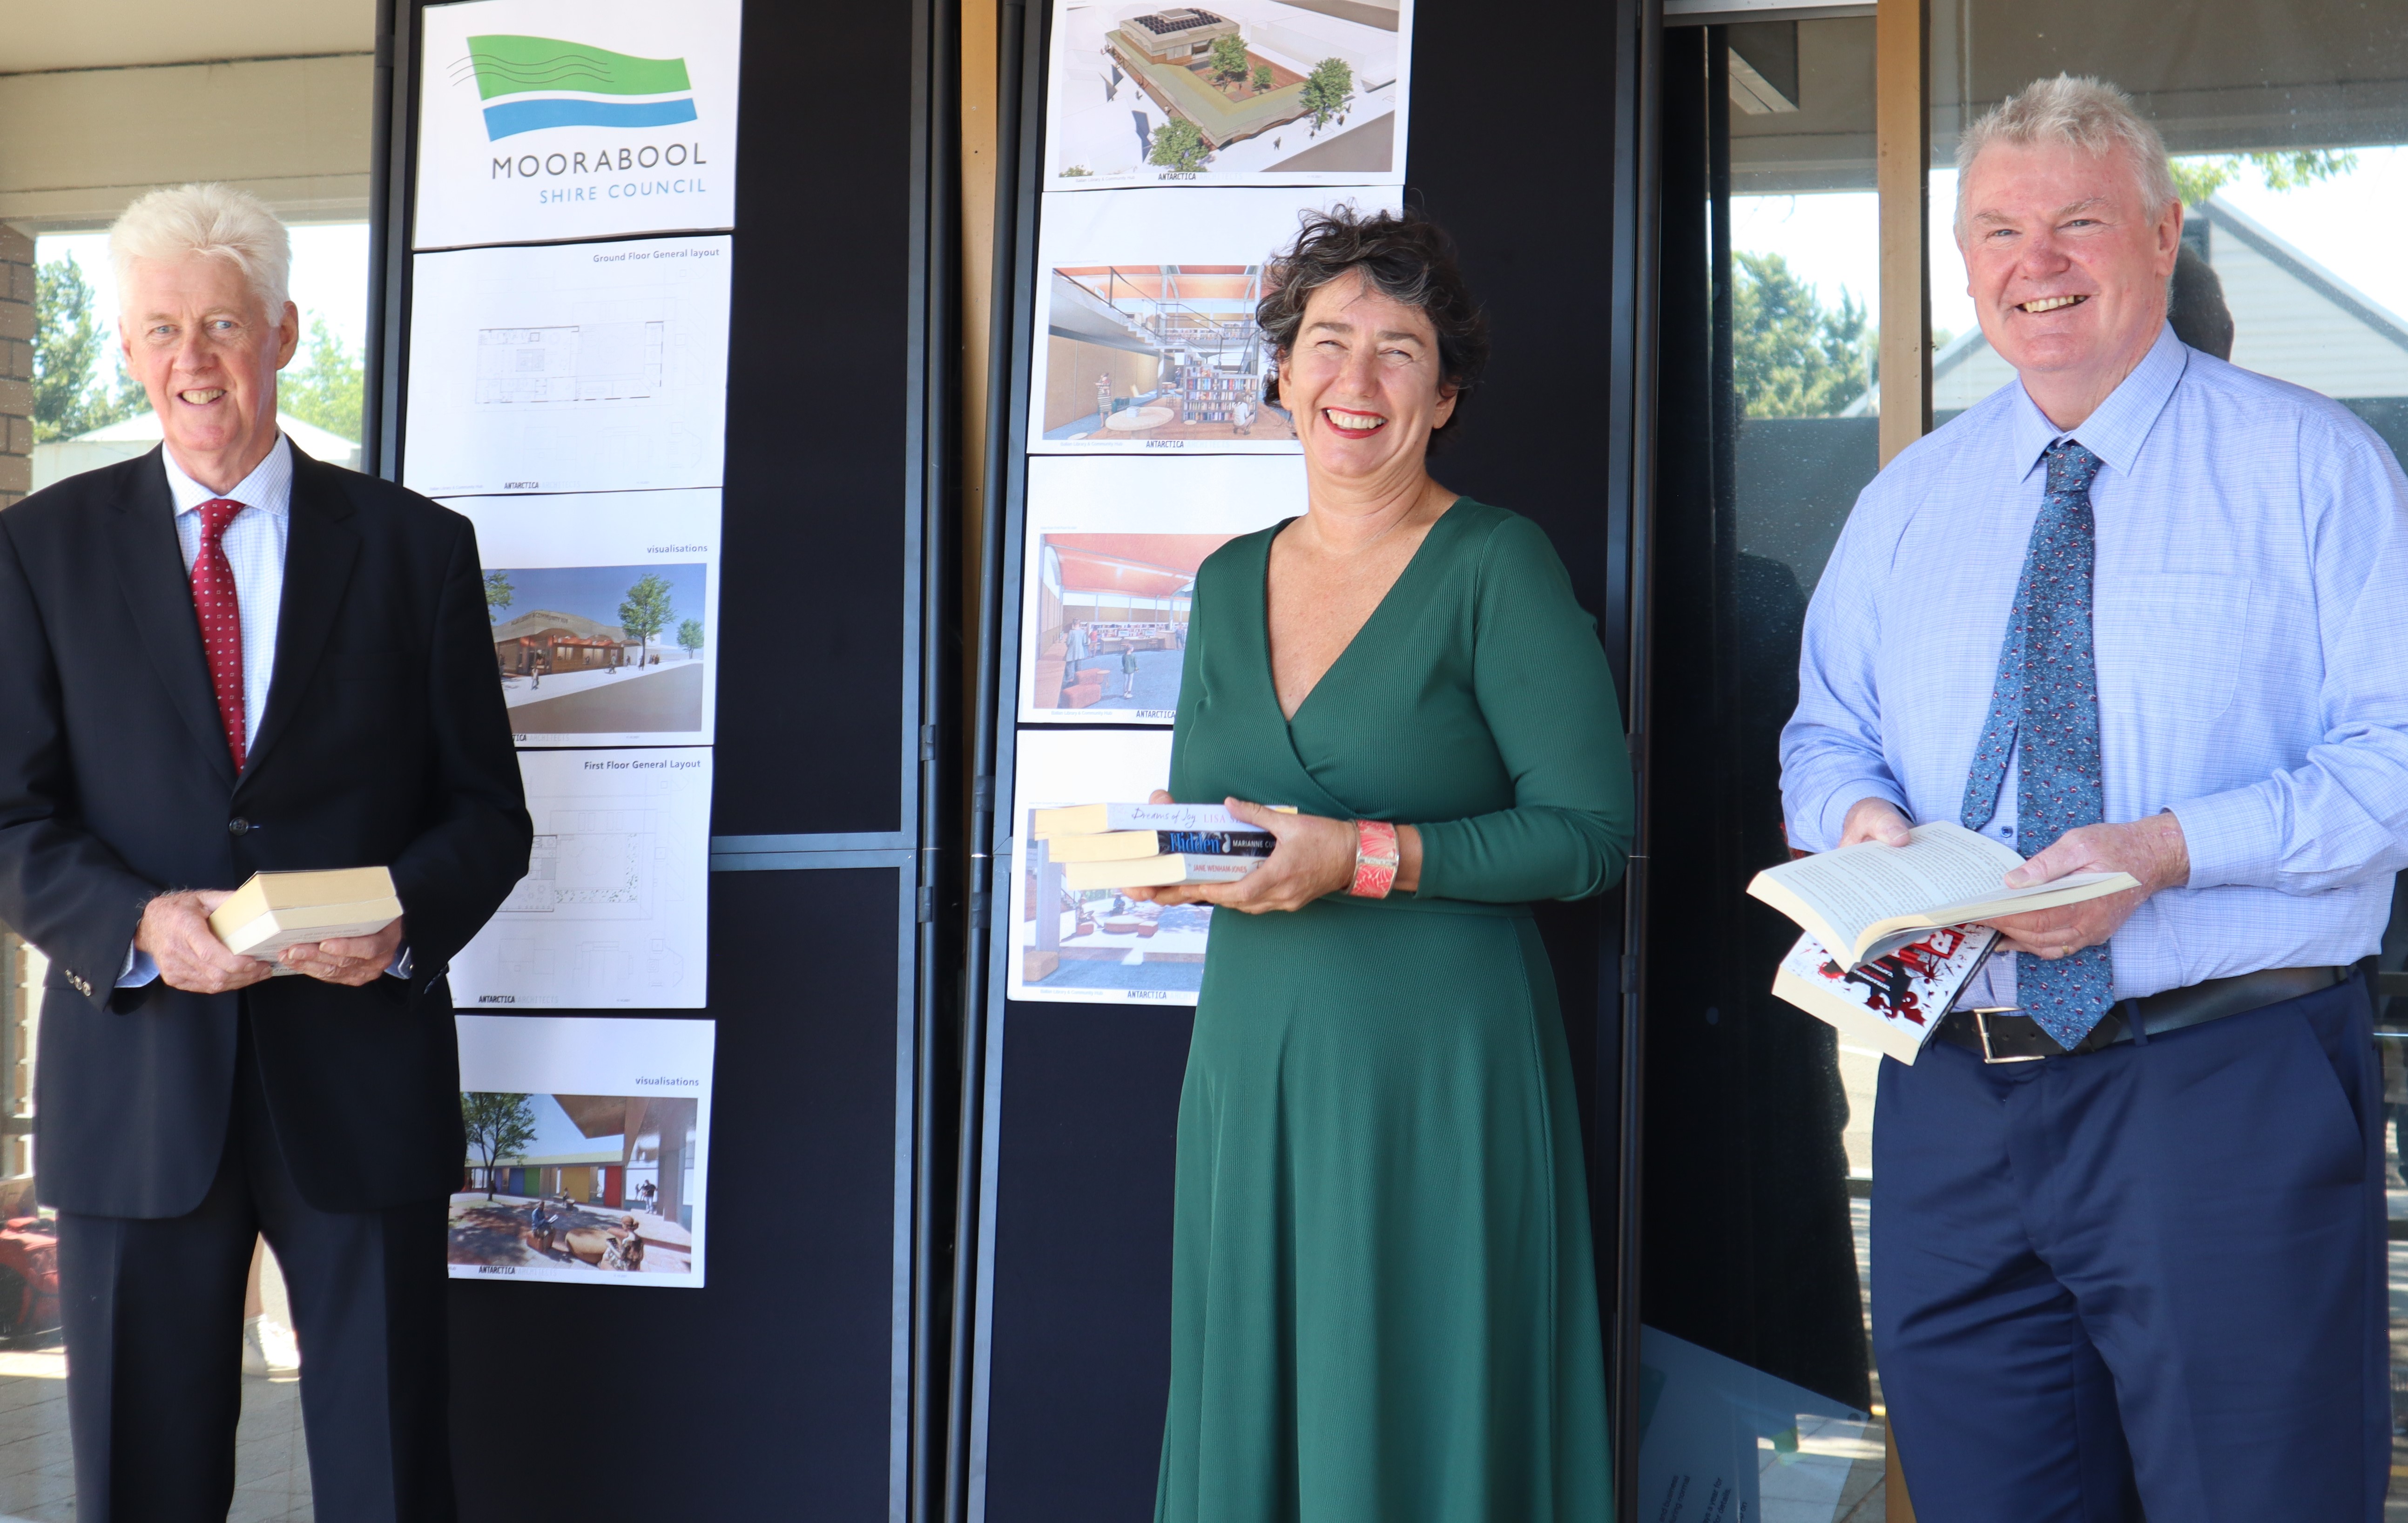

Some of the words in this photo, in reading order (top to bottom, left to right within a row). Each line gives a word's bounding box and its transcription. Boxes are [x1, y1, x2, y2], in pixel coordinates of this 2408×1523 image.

[492, 142, 707, 179] MOORABOOL
[540, 187, 597, 203] SHIRE
[608, 179, 706, 199] COUNCIL
[593, 253, 625, 262] Ground
[653, 249, 688, 258] General
[691, 249, 719, 258] layout
[647, 543, 708, 554] visualisations
[584, 761, 604, 770] First
[606, 760, 629, 770] Floor
[632, 759, 667, 769] General
[670, 759, 701, 769] Layout
[1132, 807, 1169, 820] Dreams
[1171, 810, 1180, 824] of
[1181, 808, 1196, 828] Joy
[1204, 814, 1226, 823] LISA
[1170, 832, 1221, 854] Hidden
[1233, 839, 1263, 848] MARIANNE
[1194, 864, 1206, 872] JANE
[1207, 865, 1248, 873] WENHAM-JONES
[479, 995, 515, 1003] ANTARCTICA
[1127, 990, 1167, 999] ANTARCTICA
[635, 1076, 699, 1086] visualisations
[479, 1266, 515, 1274] ANTARCTICA
[1678, 1475, 1691, 1502] normal
[1713, 1477, 1723, 1489] for
[1659, 1508, 1667, 1522] and
[1664, 1475, 1680, 1507] business
[1710, 1489, 1719, 1506] year
[1718, 1488, 1732, 1514] details.
[1740, 1502, 1748, 1512] on
